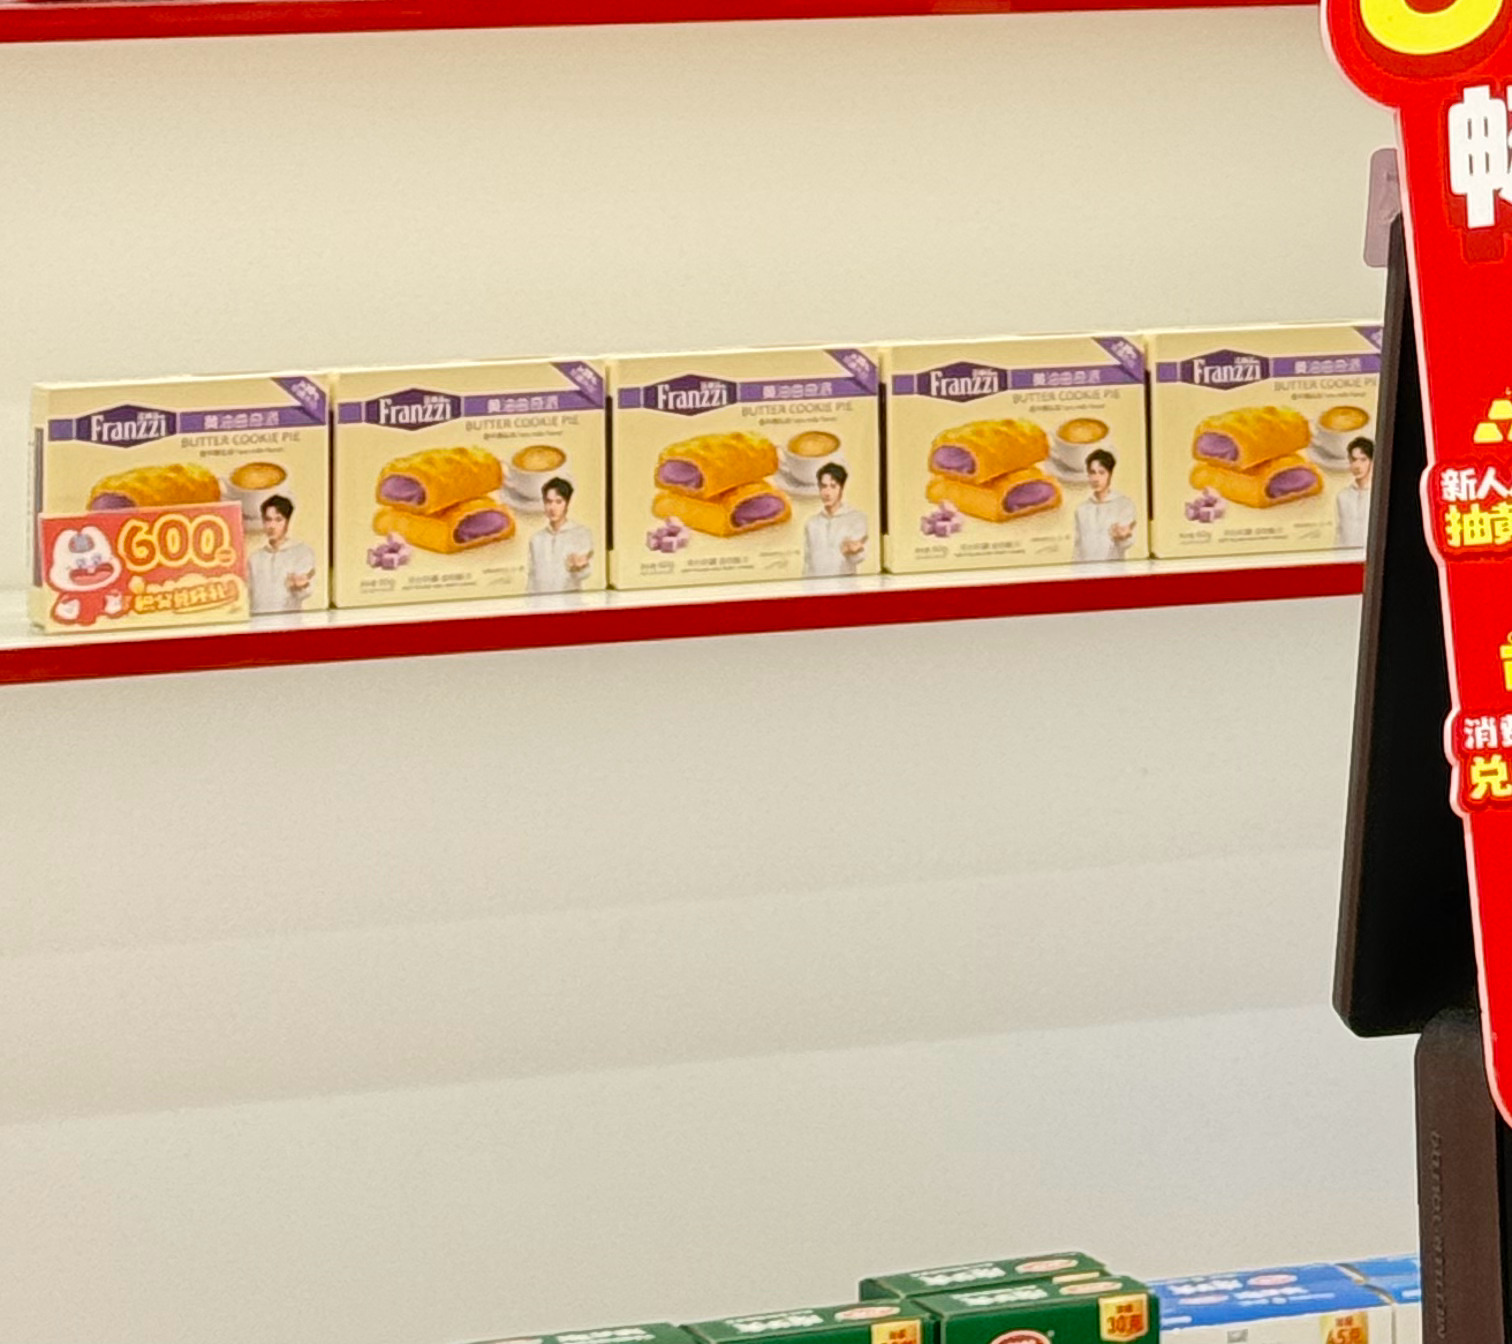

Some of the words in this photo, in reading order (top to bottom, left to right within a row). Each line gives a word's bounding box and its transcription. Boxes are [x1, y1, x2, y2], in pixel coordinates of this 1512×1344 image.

[929, 368, 999, 397] Franzzi
[1192, 358, 1262, 386] Franzzi
[656, 382, 728, 410] Franzzi
[379, 397, 451, 425] Franzzi
[91, 413, 167, 443] Franzzi
[121, 518, 231, 565] 600
